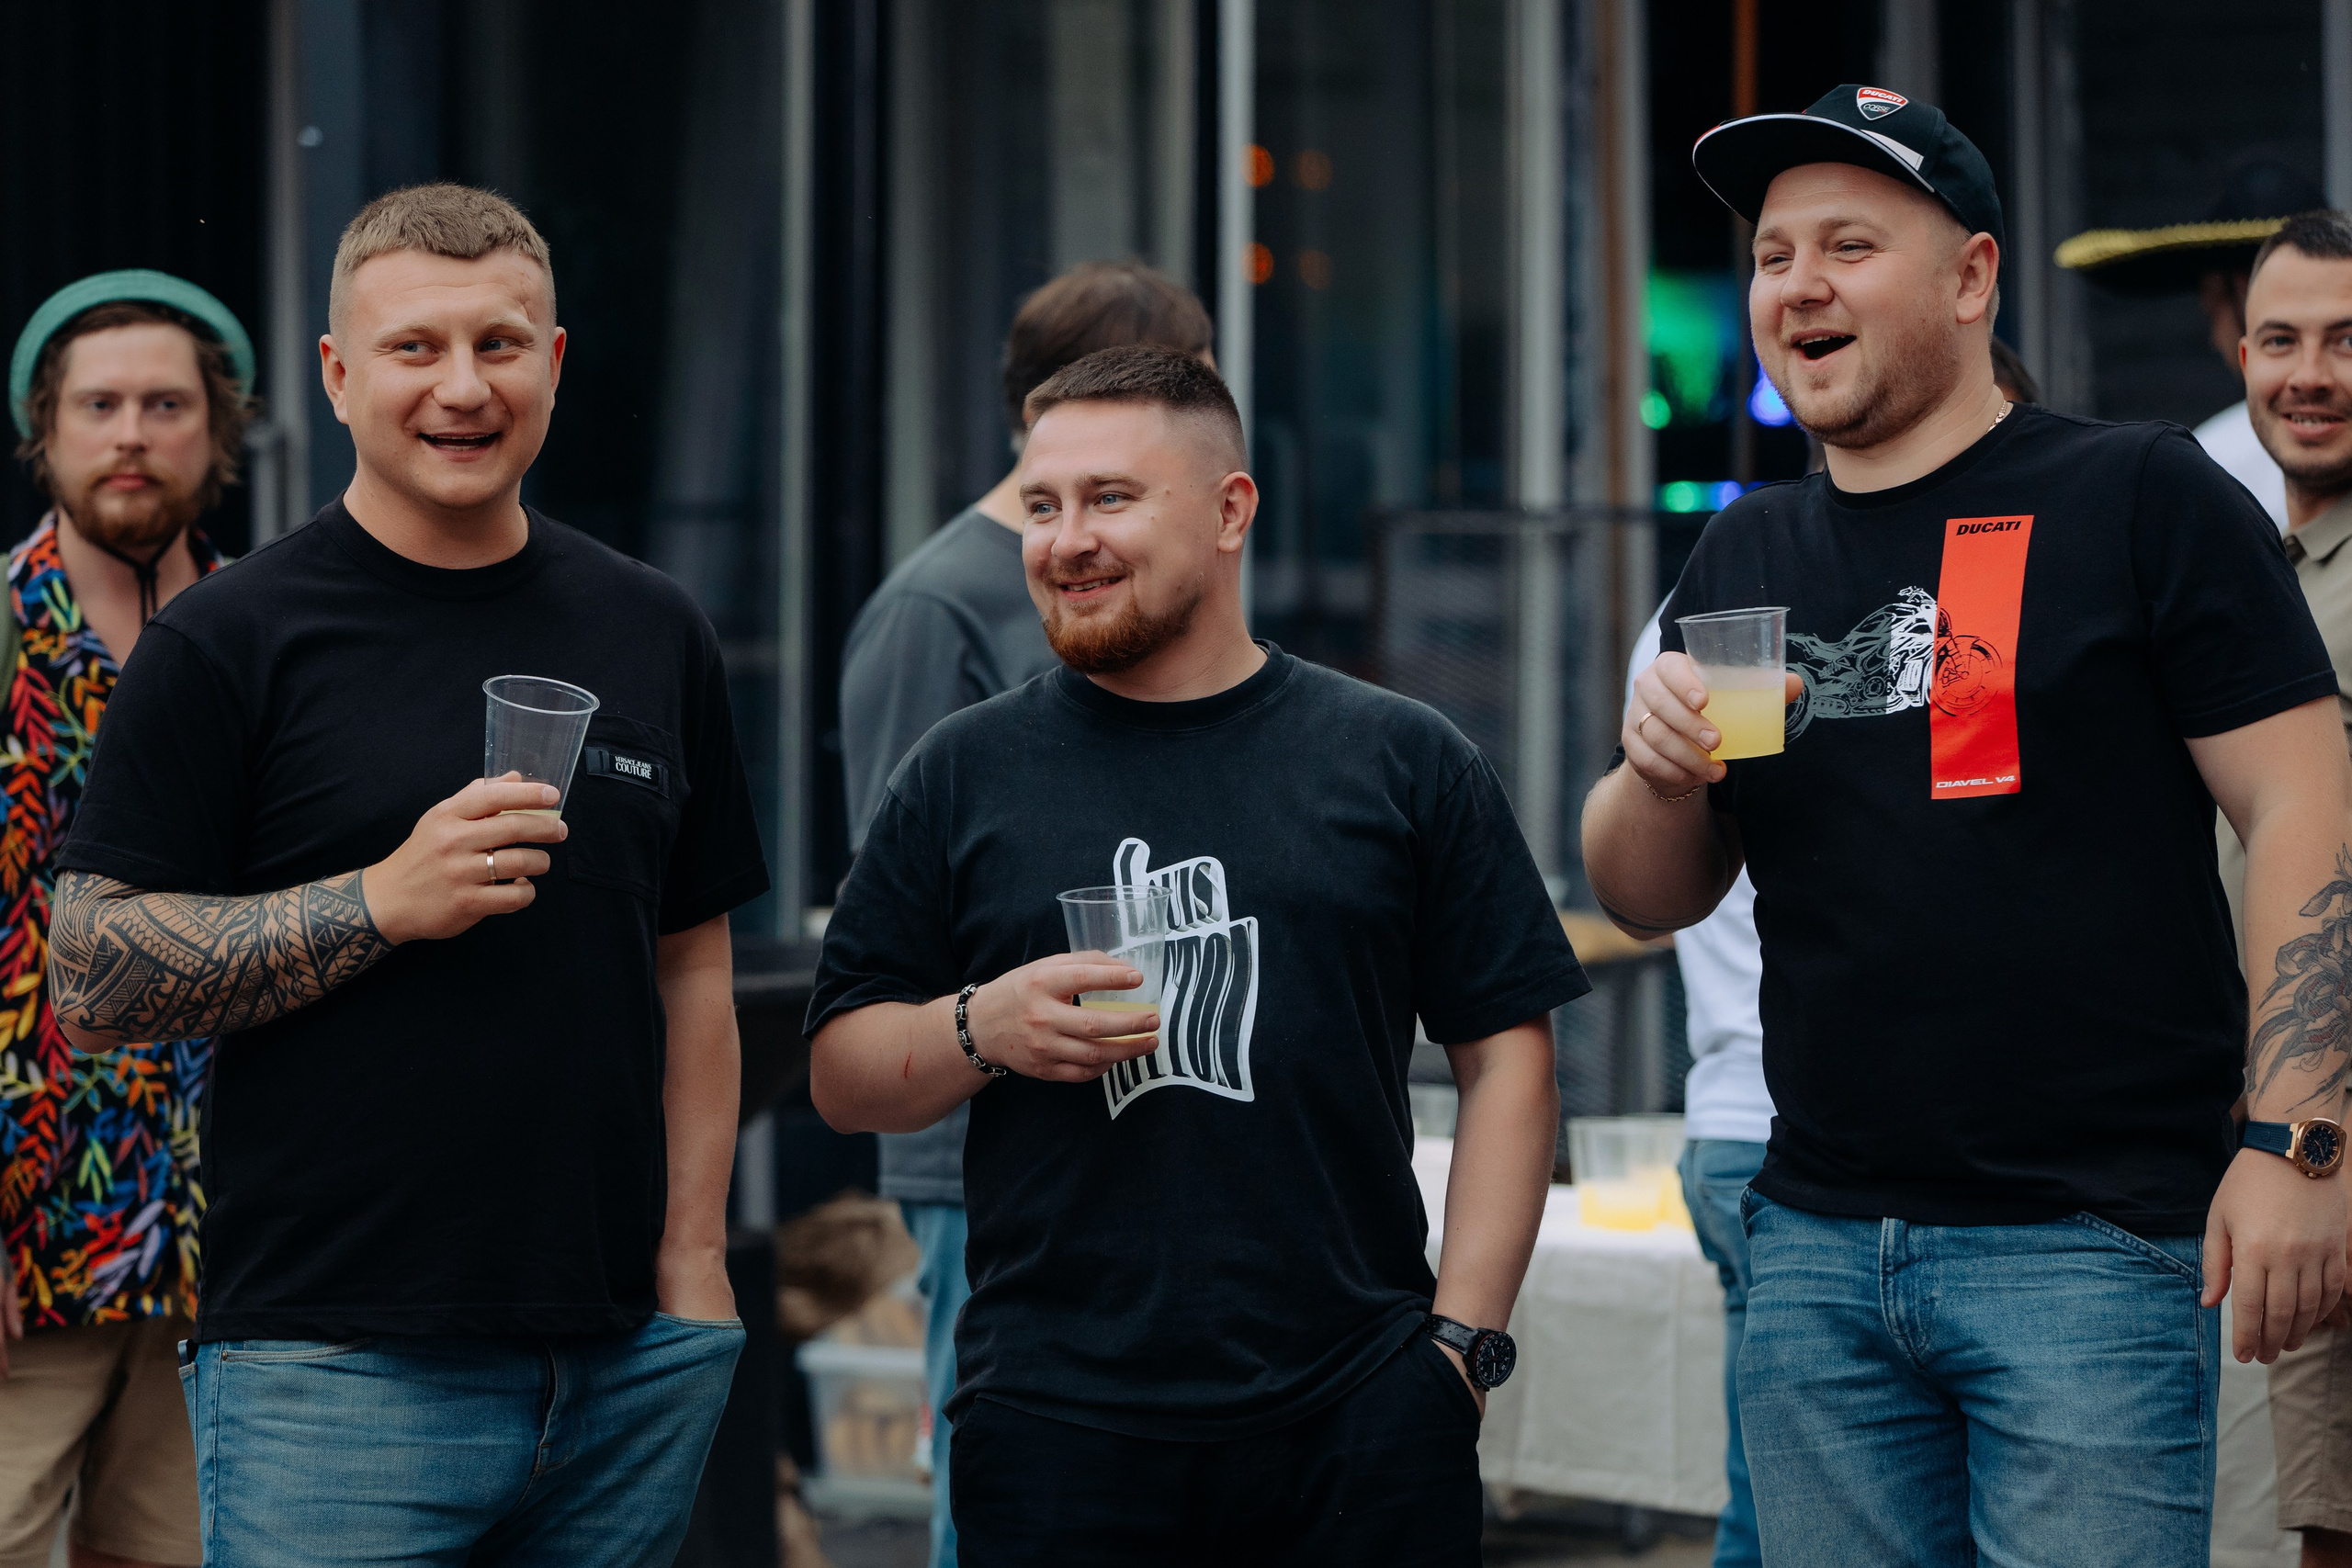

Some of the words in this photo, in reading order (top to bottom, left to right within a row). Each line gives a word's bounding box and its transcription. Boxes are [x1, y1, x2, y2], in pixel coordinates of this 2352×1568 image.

[1862, 89, 1905, 103] DUCATI
[1863, 104, 1891, 113] CORSE
[1956, 521, 2021, 536] DUCATI
[615, 756, 636, 766] VERSACE
[636, 760, 652, 771] JEANS
[615, 761, 652, 779] COUTURE
[1936, 778, 1994, 788] DIAVEL
[1995, 775, 2016, 784] V4
